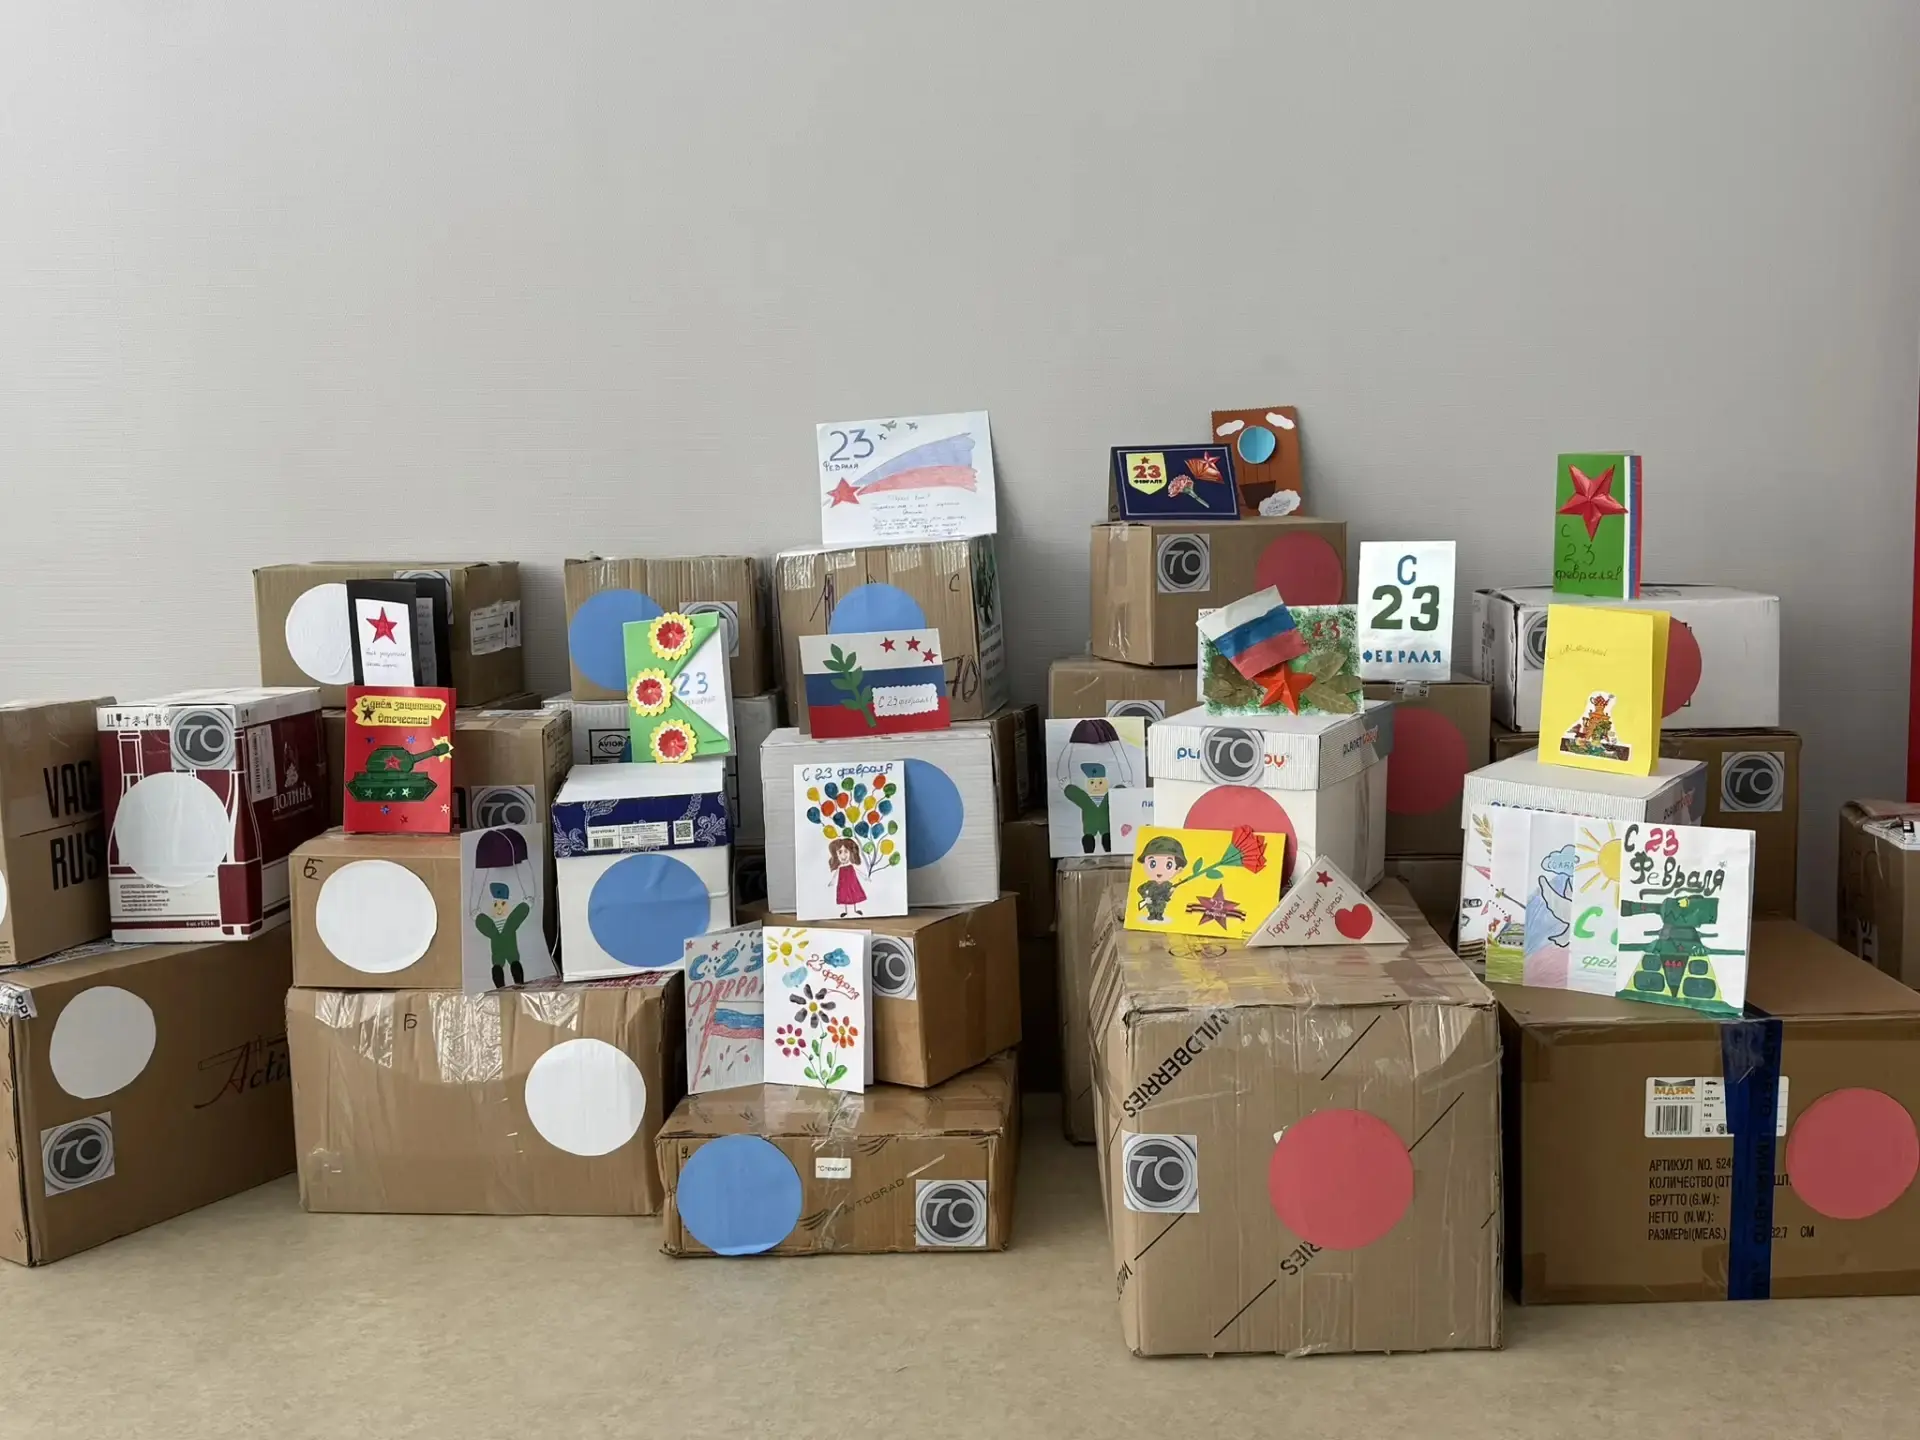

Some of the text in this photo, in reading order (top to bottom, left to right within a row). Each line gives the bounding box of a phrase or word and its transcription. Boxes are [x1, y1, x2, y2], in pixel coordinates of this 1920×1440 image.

[829, 428, 875, 461] 23
[1133, 464, 1162, 478] 23
[1561, 524, 1570, 538] С
[1165, 550, 1202, 575] 70
[1564, 543, 1595, 566] 23
[1397, 554, 1417, 585] С
[1370, 584, 1440, 631] 23
[1362, 650, 1441, 663] ФЕВРАЛЯ
[679, 672, 709, 696] 23
[361, 697, 442, 711] С днём защитника
[886, 696, 898, 706] 23
[378, 713, 430, 725] Отечества!
[179, 724, 226, 753] 70
[1209, 735, 1255, 768] 70
[815, 767, 833, 780] 23
[836, 762, 894, 778] февраля
[1731, 767, 1775, 794] 70
[271, 785, 313, 813] ДОЛИНА
[1624, 824, 1679, 856] С 23
[1210, 898, 1224, 910] 23
[1573, 906, 1604, 938] С
[689, 954, 709, 981] С
[806, 953, 828, 974] 23
[872, 950, 907, 982] 70
[1122, 1007, 1230, 1118] WILDBERRIES
[1654, 1086, 1695, 1095] МАЯК
[55, 1134, 103, 1172] 70
[1649, 1157, 1734, 1172] АРТИКУЛ NO. 524
[1131, 1155, 1187, 1191] 70
[1649, 1176, 1713, 1189] КОЛИЧЕСТВО
[1715, 1175, 1732, 1189] (QT
[1649, 1193, 1720, 1207] БРУТТО (G.W.):
[926, 1198, 978, 1228] 70
[1648, 1211, 1715, 1224] НЕТТО (N.W.):
[1800, 1225, 1815, 1238] СМ
